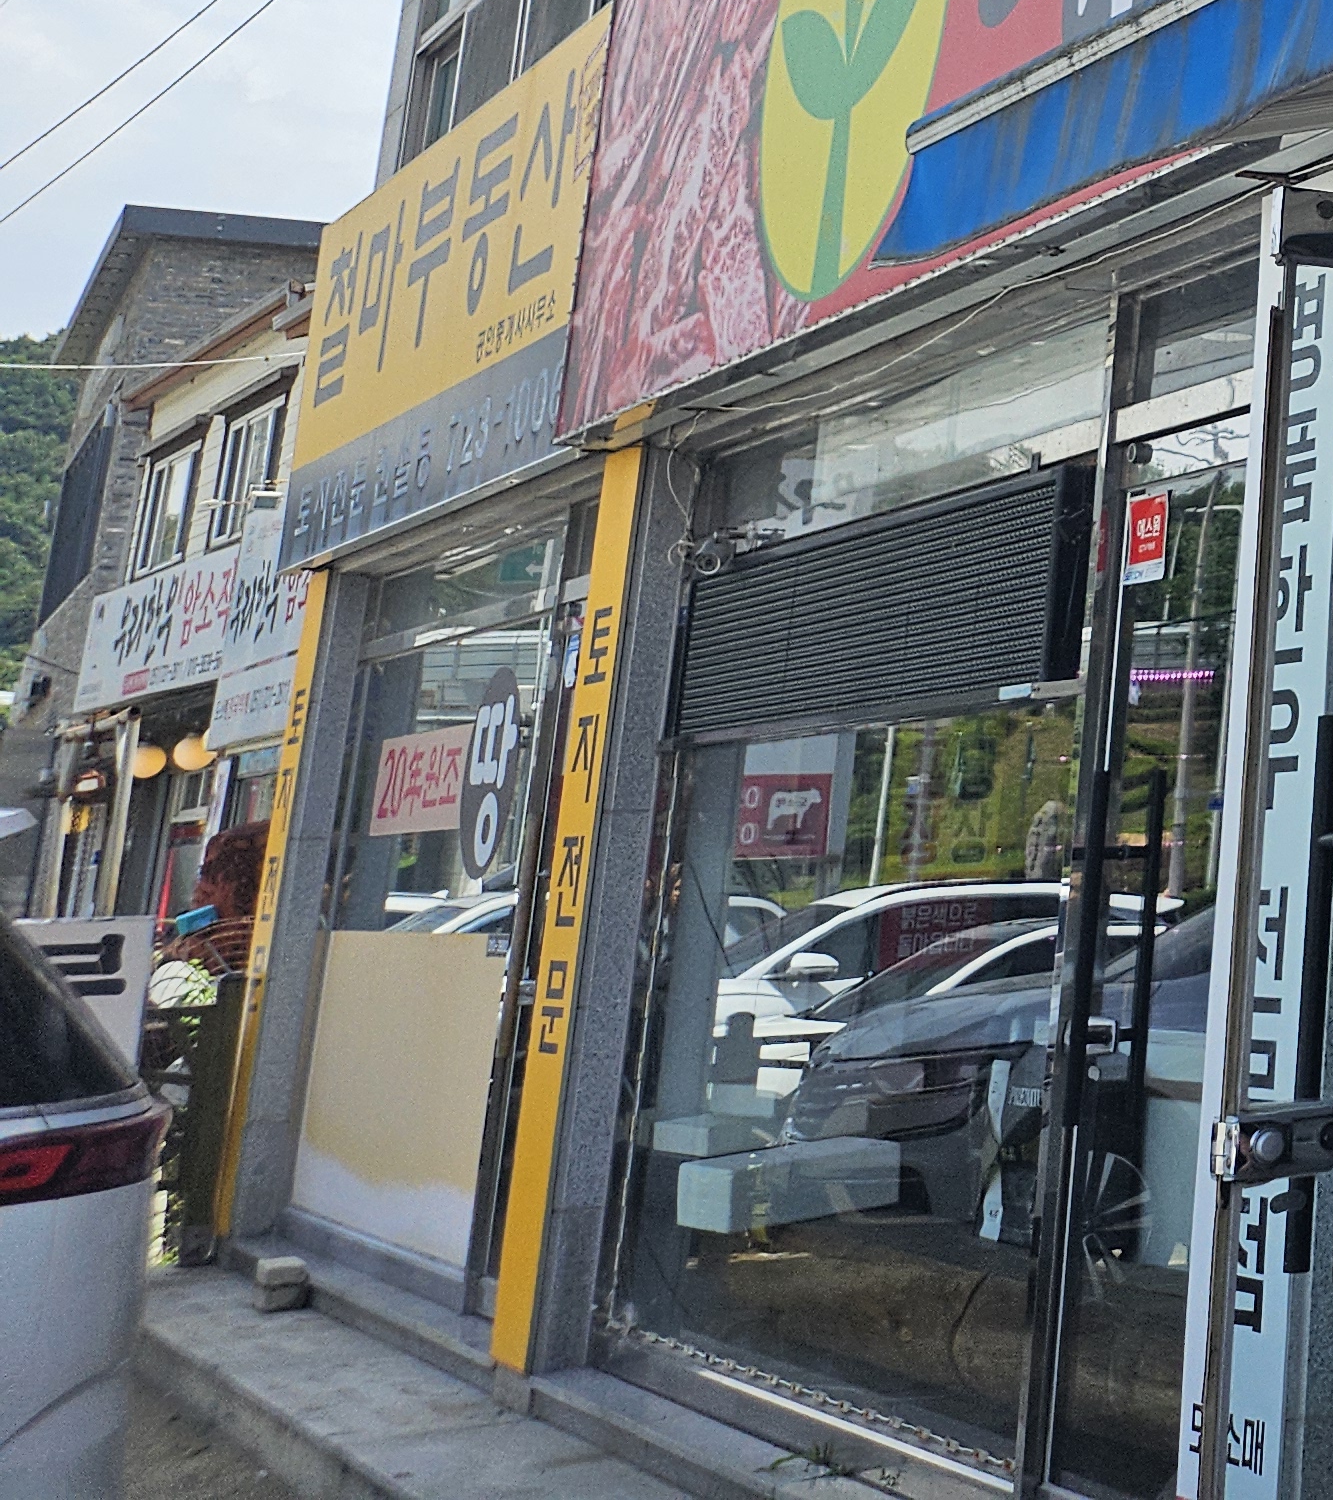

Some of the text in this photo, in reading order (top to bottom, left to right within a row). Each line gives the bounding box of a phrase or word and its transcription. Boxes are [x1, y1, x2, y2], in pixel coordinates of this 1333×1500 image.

[314, 67, 577, 409] 철마부동산
[1136, 514, 1162, 540] 에스원
[469, 693, 518, 868] 땅
[536, 605, 613, 1057] 토지전문
